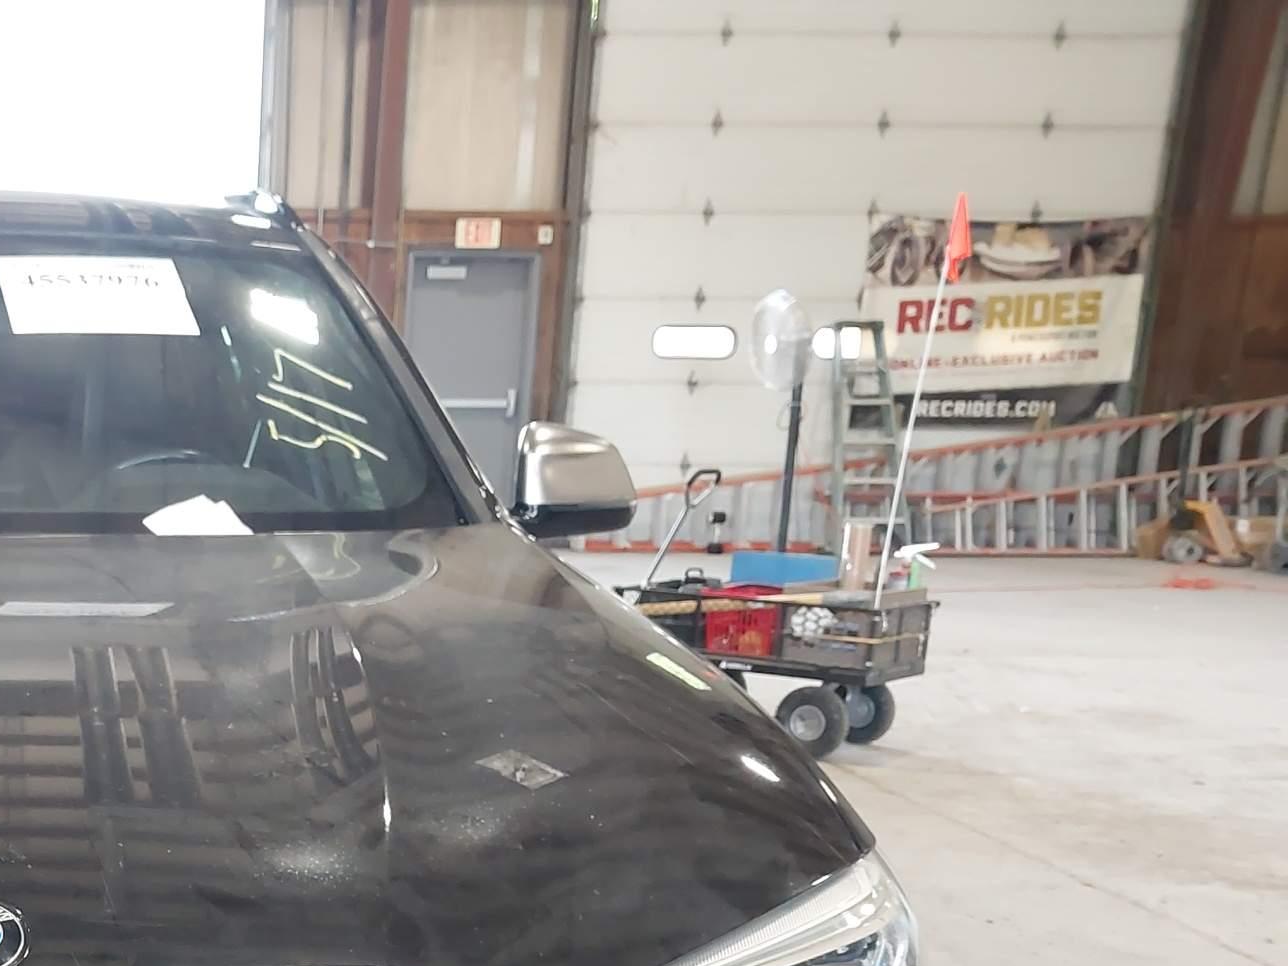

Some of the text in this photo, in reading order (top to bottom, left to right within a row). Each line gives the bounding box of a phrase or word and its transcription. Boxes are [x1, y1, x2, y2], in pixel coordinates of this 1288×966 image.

[897, 291, 1102, 334] REC RIDES
[888, 352, 1033, 370] ONLNE-EXCLUSIVE
